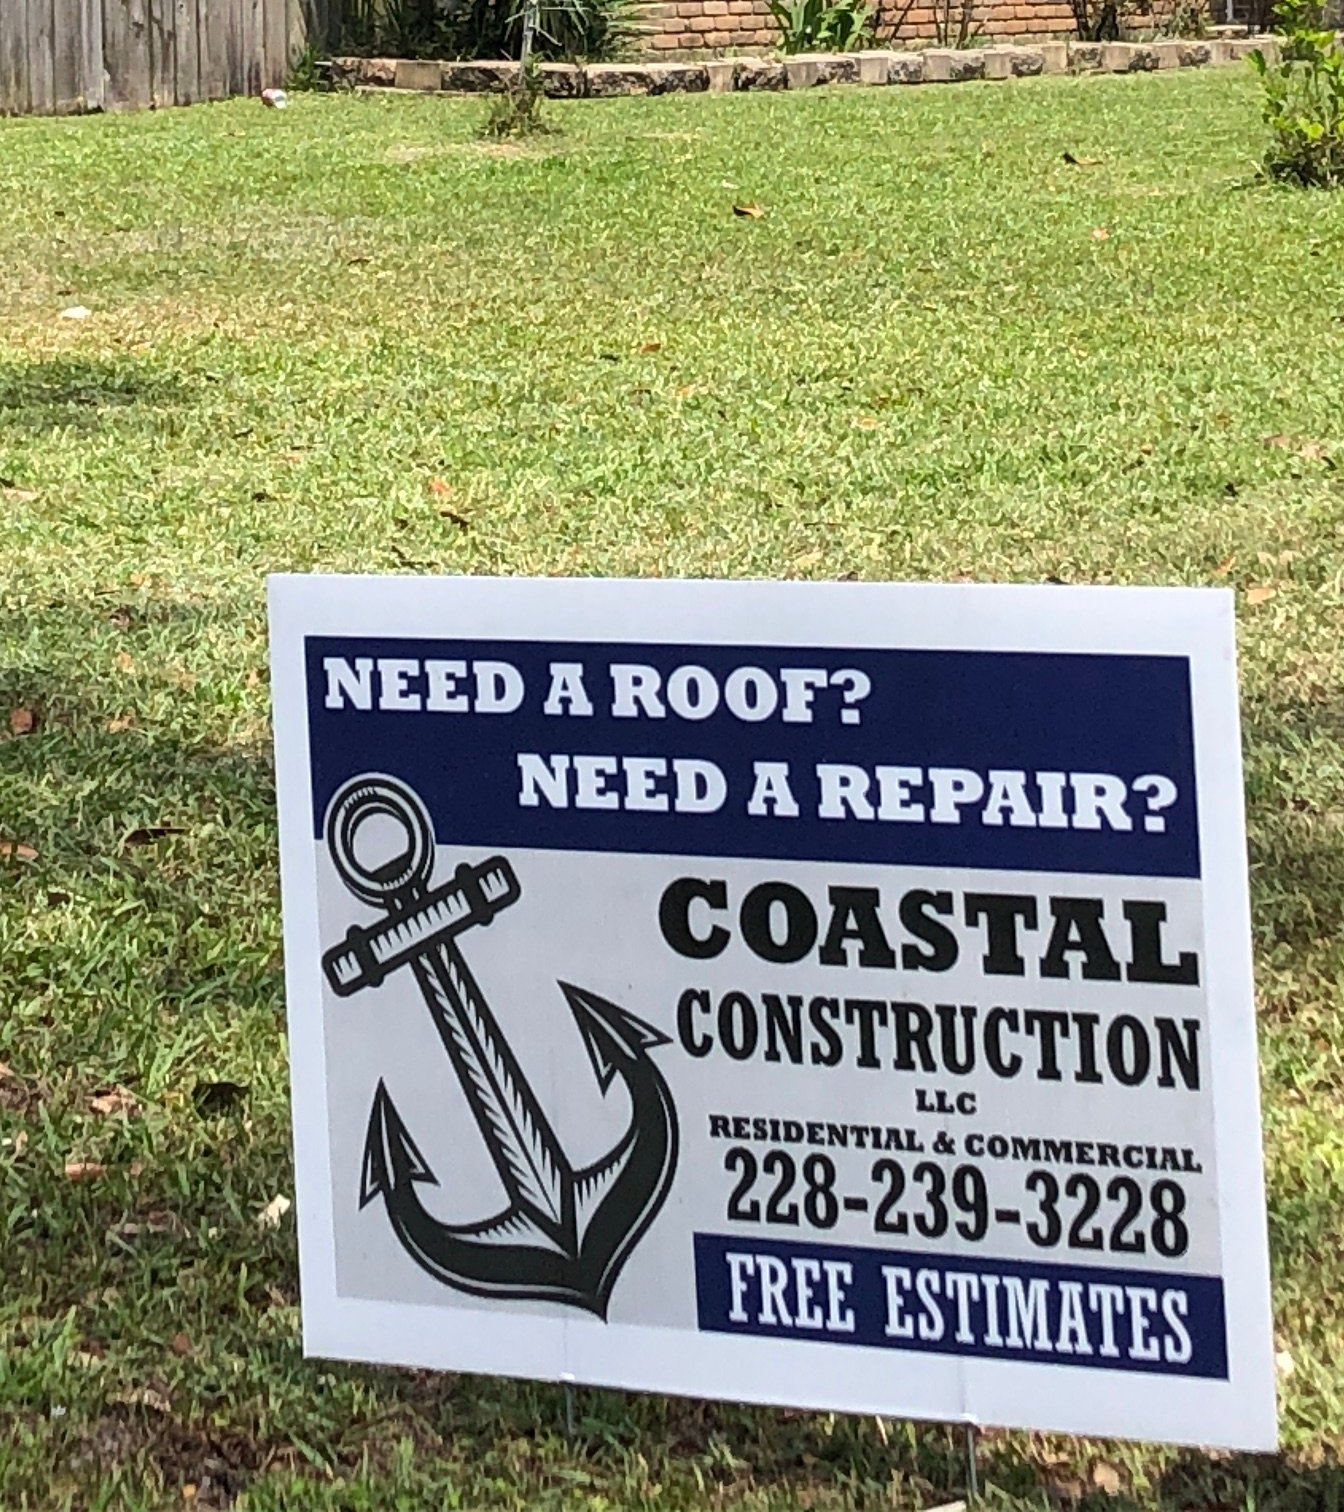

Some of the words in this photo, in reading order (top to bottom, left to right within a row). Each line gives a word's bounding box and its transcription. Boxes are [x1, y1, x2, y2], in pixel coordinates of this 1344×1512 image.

[324, 656, 525, 716] NEED
[543, 661, 594, 718] A
[609, 663, 873, 725] ROOF?
[517, 753, 729, 816] NEED
[747, 762, 800, 819] A
[817, 764, 1179, 833] REPAIR?
[658, 877, 1201, 988] COASTAL
[676, 988, 1202, 1091] CONSTRUCTION
[708, 1114, 924, 1154] RESIDENTIAL
[932, 1132, 956, 1156] &
[964, 1133, 1203, 1174] COMMERCIAL
[915, 1089, 977, 1115] LLC
[724, 1146, 1189, 1258] 228-239-3228
[725, 1252, 856, 1333] FREE
[881, 1265, 1193, 1364] ESTIMATES
